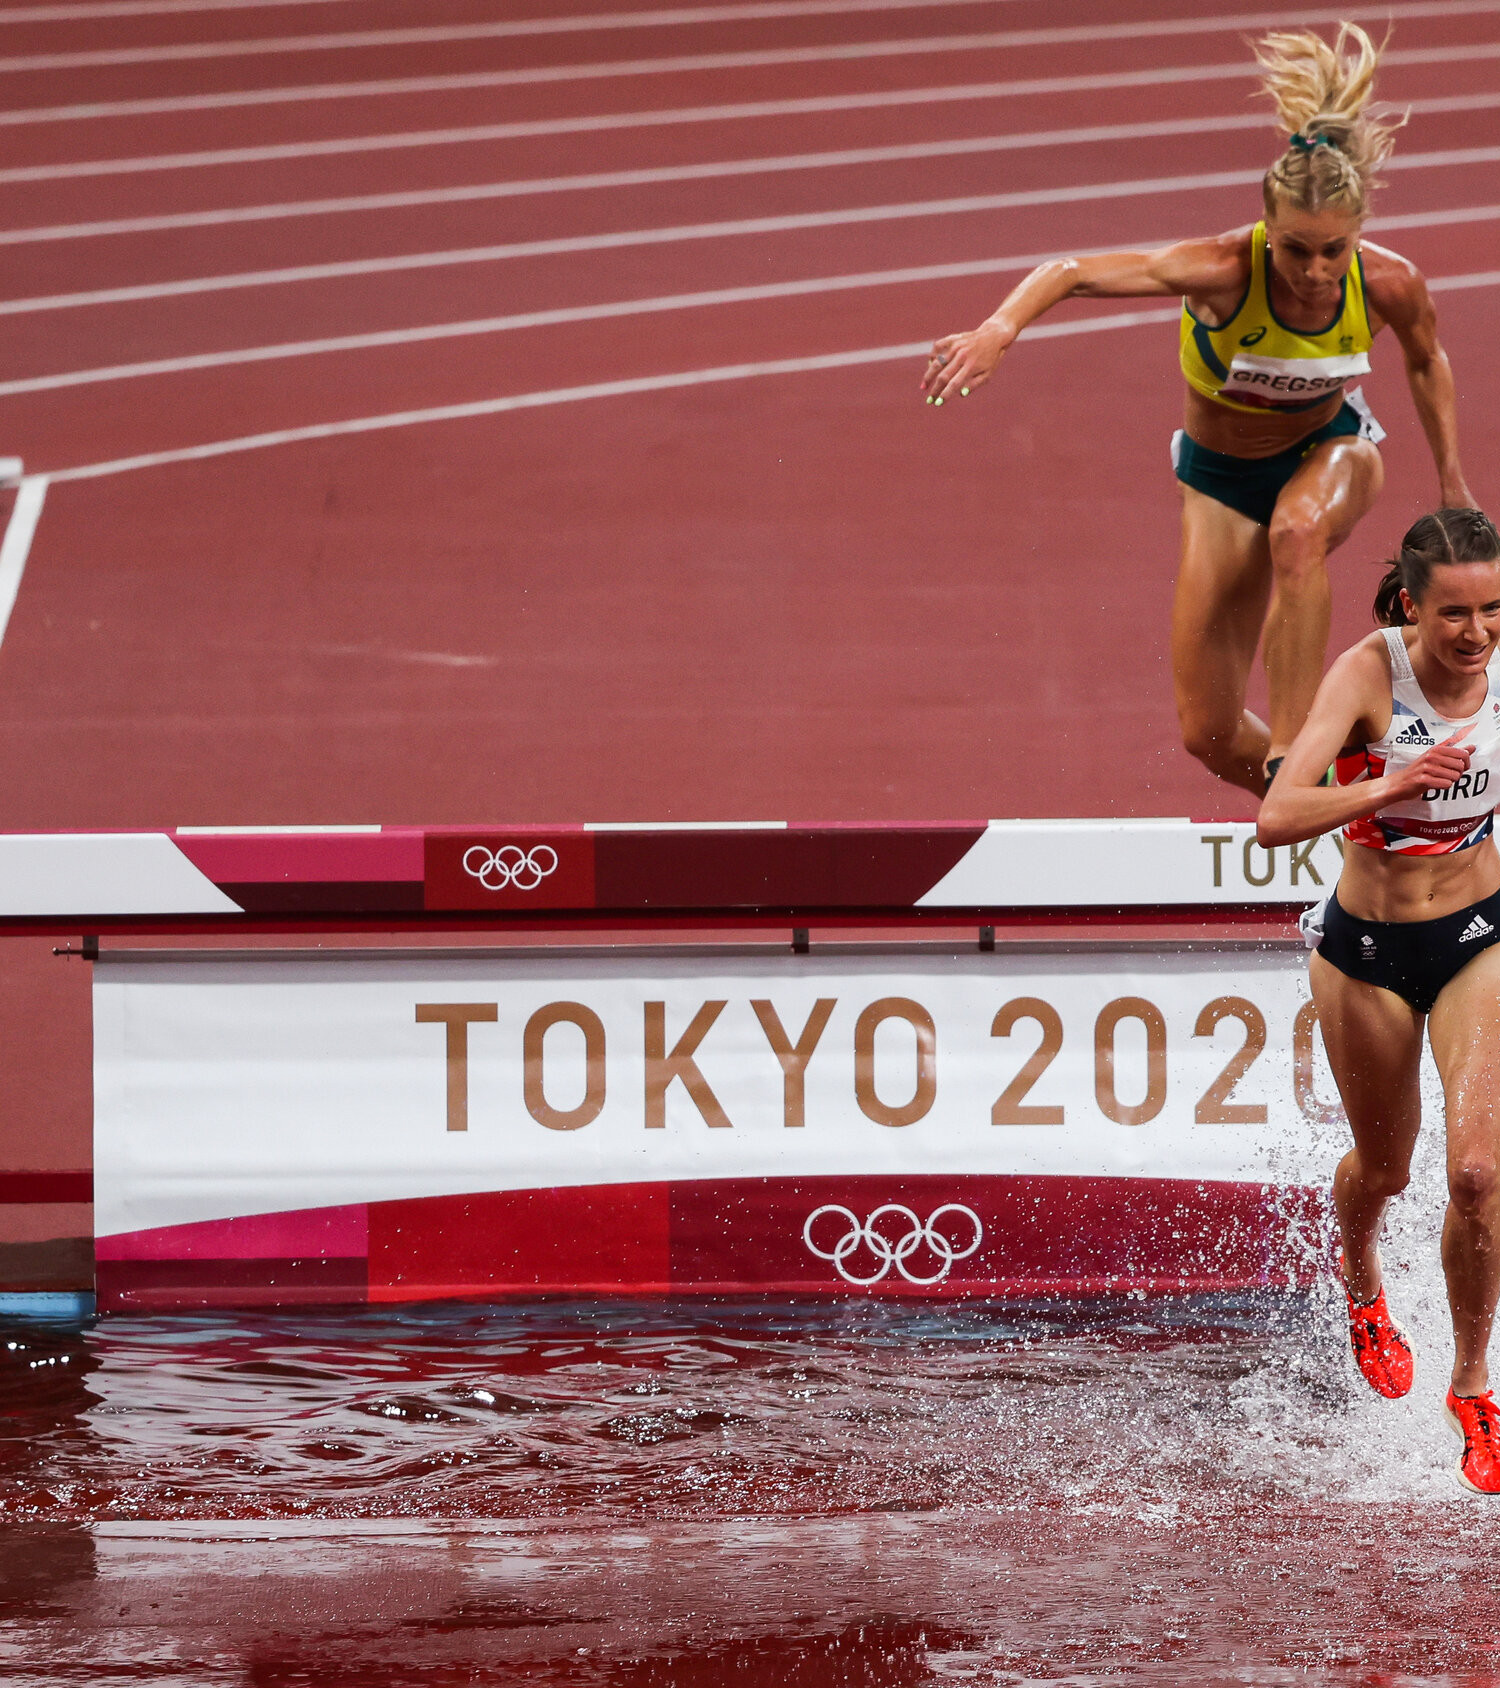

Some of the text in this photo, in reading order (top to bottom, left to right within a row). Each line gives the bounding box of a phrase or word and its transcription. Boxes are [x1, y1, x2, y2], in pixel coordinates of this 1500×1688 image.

[1232, 370, 1355, 392] GREGSO
[1395, 733, 1435, 746] adidas
[1442, 826, 1459, 834] 2020
[1201, 833, 1345, 887] TOK
[1458, 924, 1495, 943] adidas
[415, 996, 1347, 1132] TOKYO 2020
